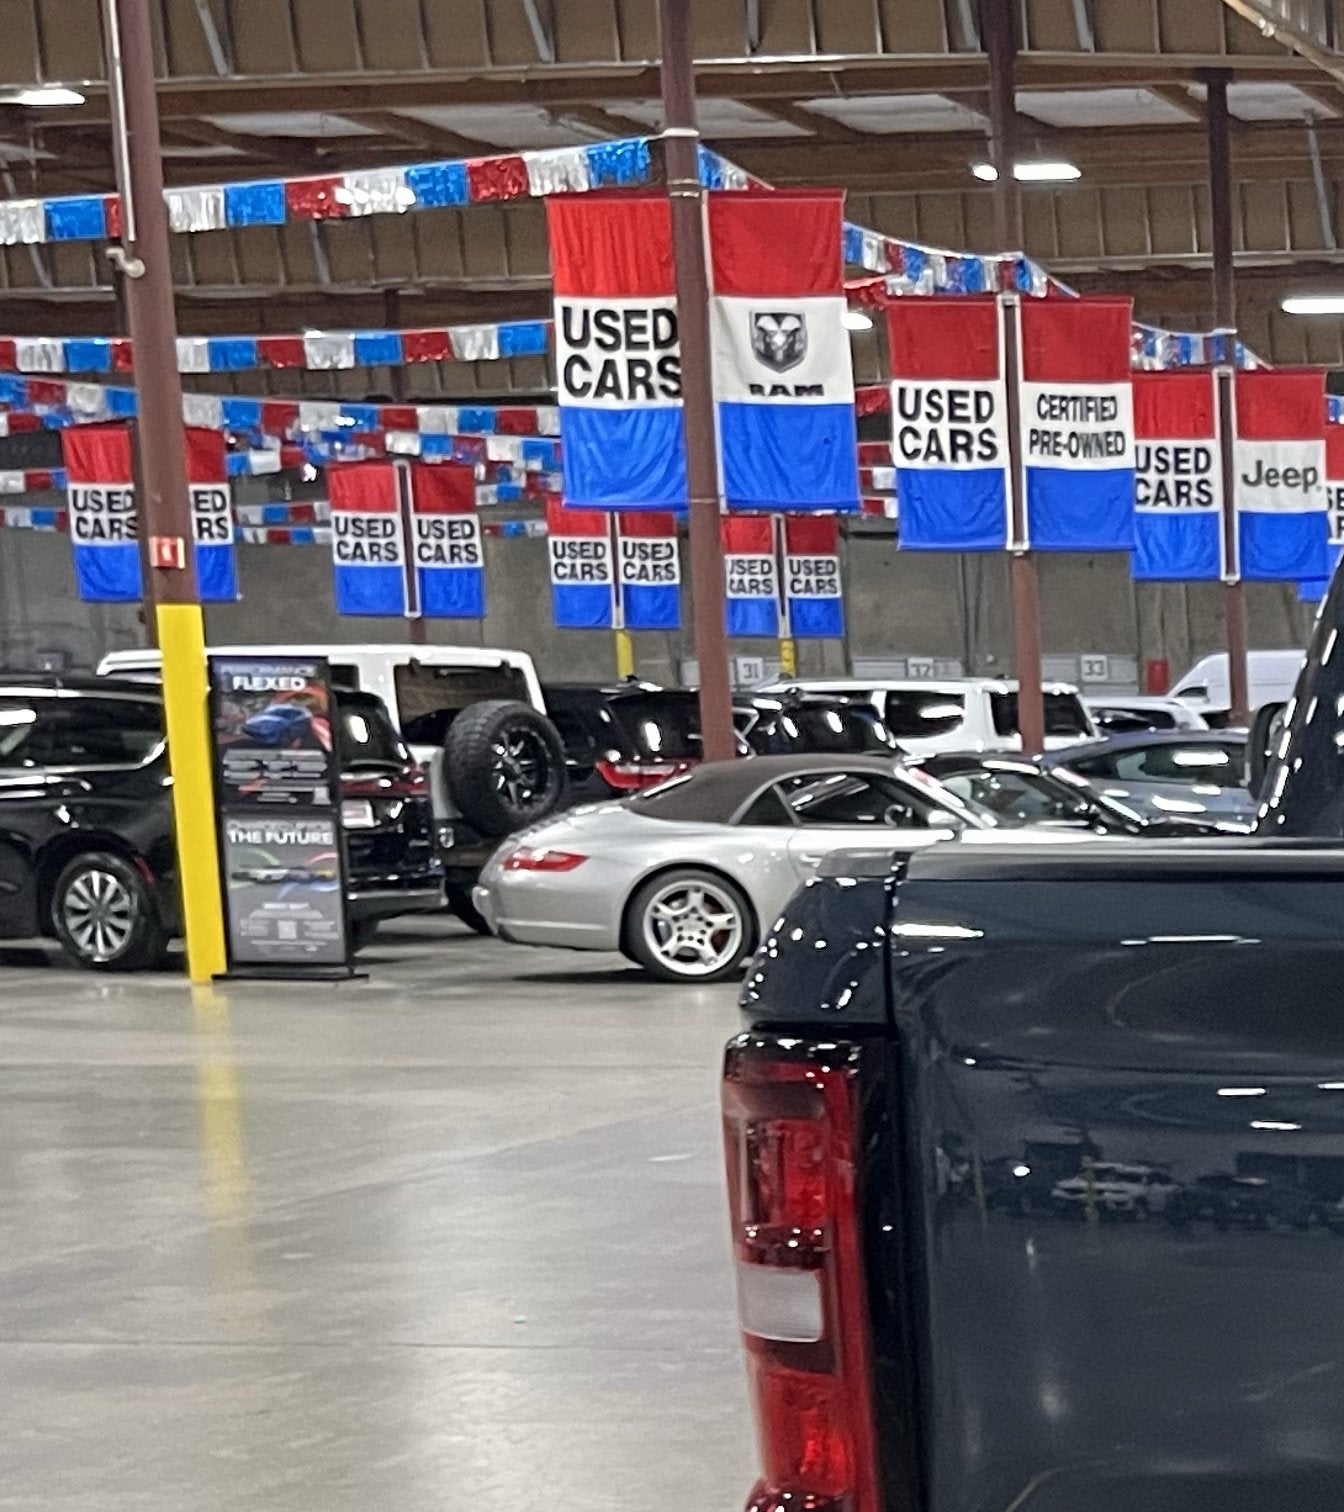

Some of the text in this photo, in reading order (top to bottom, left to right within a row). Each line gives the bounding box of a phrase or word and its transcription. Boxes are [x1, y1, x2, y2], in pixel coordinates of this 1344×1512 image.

[562, 306, 679, 351] USED
[563, 354, 682, 400] CARS
[748, 383, 825, 397] RAM
[898, 387, 995, 425] USED
[1037, 393, 1118, 423] CERTIFIED
[898, 425, 999, 463] CARS
[1029, 428, 1127, 459] PRE-OWNED
[1134, 446, 1212, 475] USED
[1242, 459, 1319, 494] Jeep
[72, 489, 135, 513] USED
[193, 490, 227, 513] ED
[1135, 478, 1214, 507] CARS
[75, 516, 139, 540] CARS
[196, 516, 228, 540] RS
[334, 517, 396, 538] USED
[417, 519, 475, 540] USED
[336, 540, 399, 562] CARS
[417, 542, 479, 563] CARS
[553, 541, 606, 560] USED
[622, 541, 675, 561] USED
[554, 561, 609, 581] CARS
[623, 561, 676, 582] CARS
[788, 559, 837, 577] USED
[790, 578, 838, 594] CARS
[1083, 660, 1106, 676] 33
[232, 676, 306, 691] FLEXED
[228, 830, 333, 845] THE FUTURE
